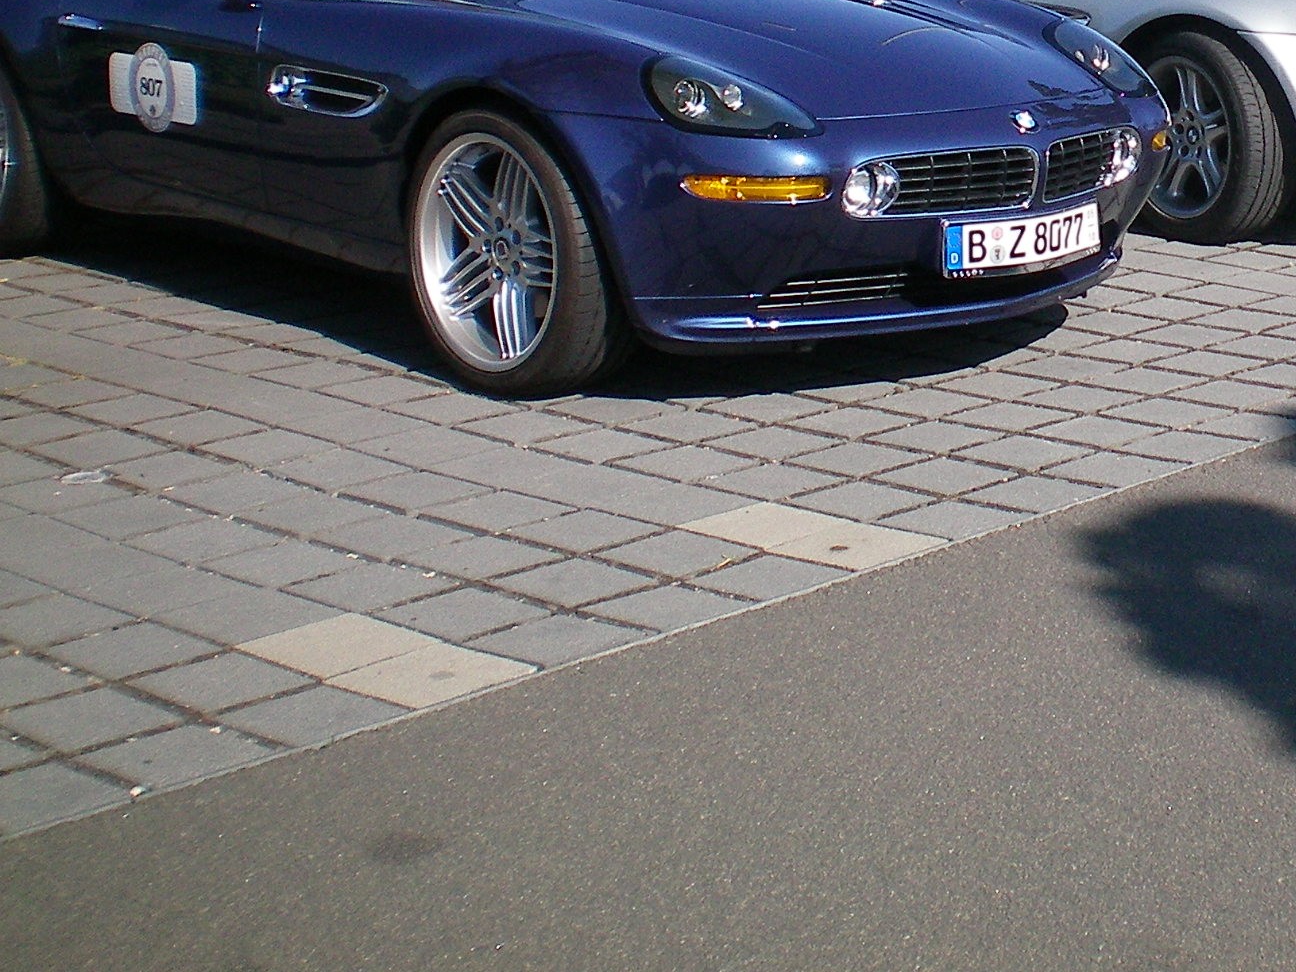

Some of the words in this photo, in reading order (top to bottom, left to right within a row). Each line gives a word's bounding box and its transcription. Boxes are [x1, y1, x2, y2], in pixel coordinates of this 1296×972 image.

[140, 76, 163, 98] 807
[968, 229, 987, 264] B
[1009, 225, 1026, 259] Z
[1034, 213, 1084, 255] 8077
[950, 252, 959, 264] D
